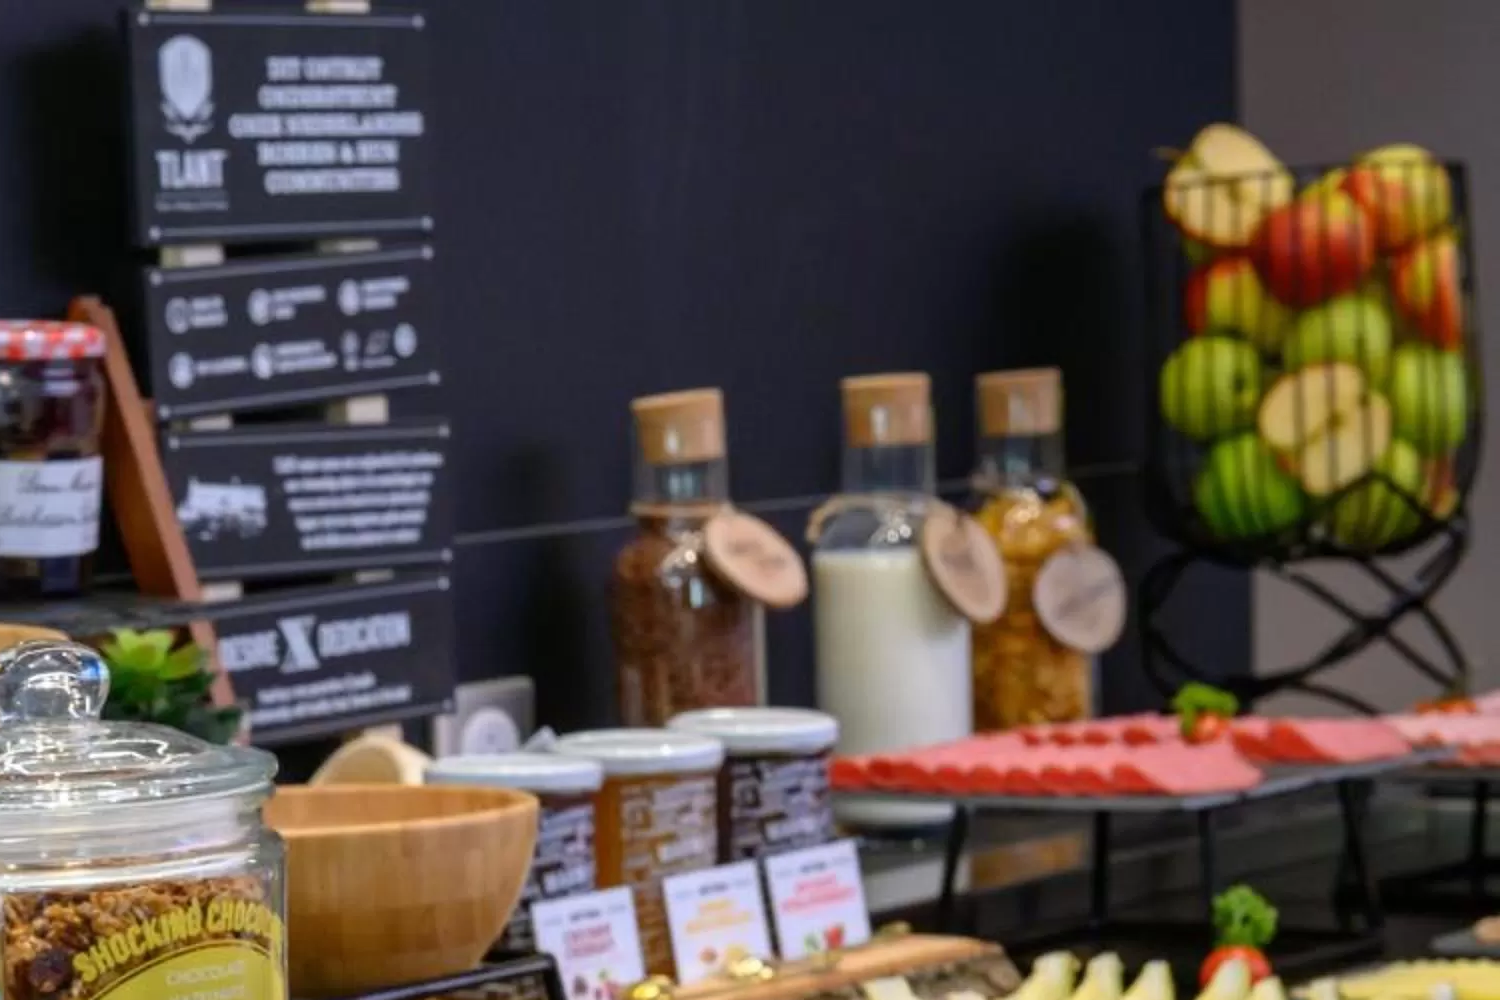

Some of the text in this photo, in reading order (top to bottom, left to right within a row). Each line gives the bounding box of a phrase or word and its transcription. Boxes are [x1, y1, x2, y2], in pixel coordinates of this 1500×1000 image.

[155, 149, 228, 189] TLANT
[277, 615, 320, 674] X
[72, 900, 202, 983] SHOCKING
